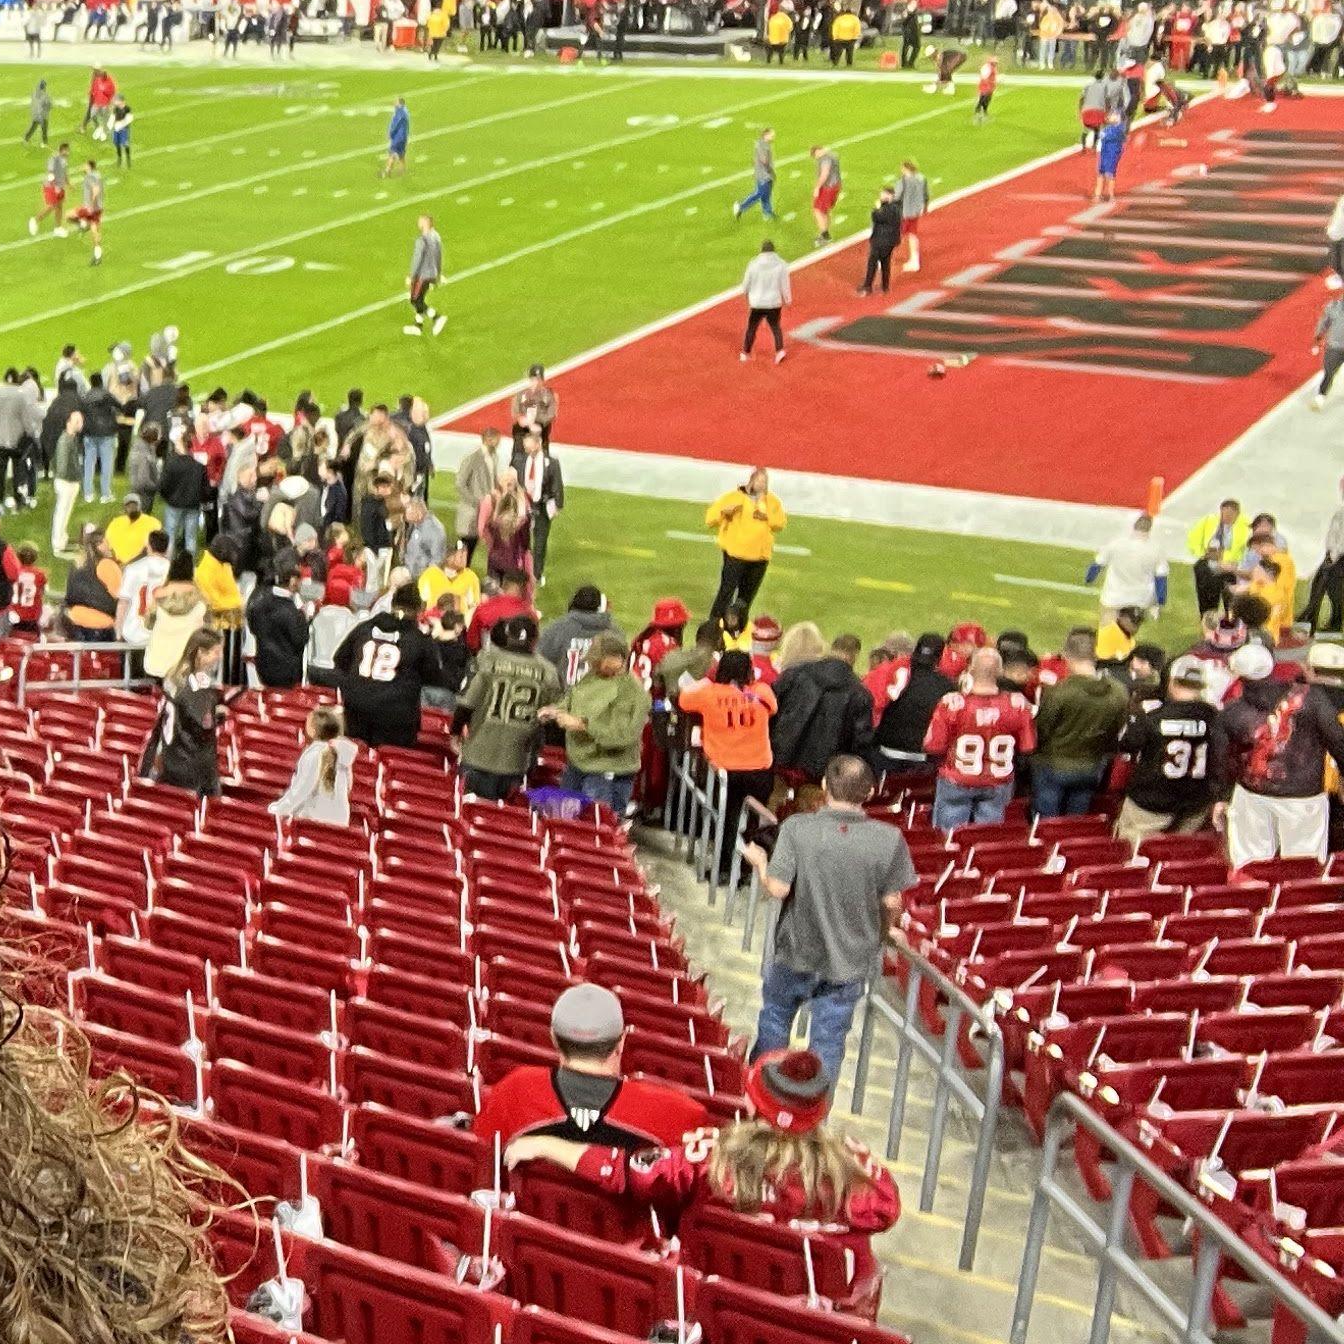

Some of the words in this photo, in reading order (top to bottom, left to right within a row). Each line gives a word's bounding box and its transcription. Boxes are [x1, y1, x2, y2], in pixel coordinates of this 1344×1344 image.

[358, 640, 401, 682] 12
[484, 678, 541, 724] 12
[955, 734, 1016, 777] 99
[1163, 739, 1208, 780] 31
